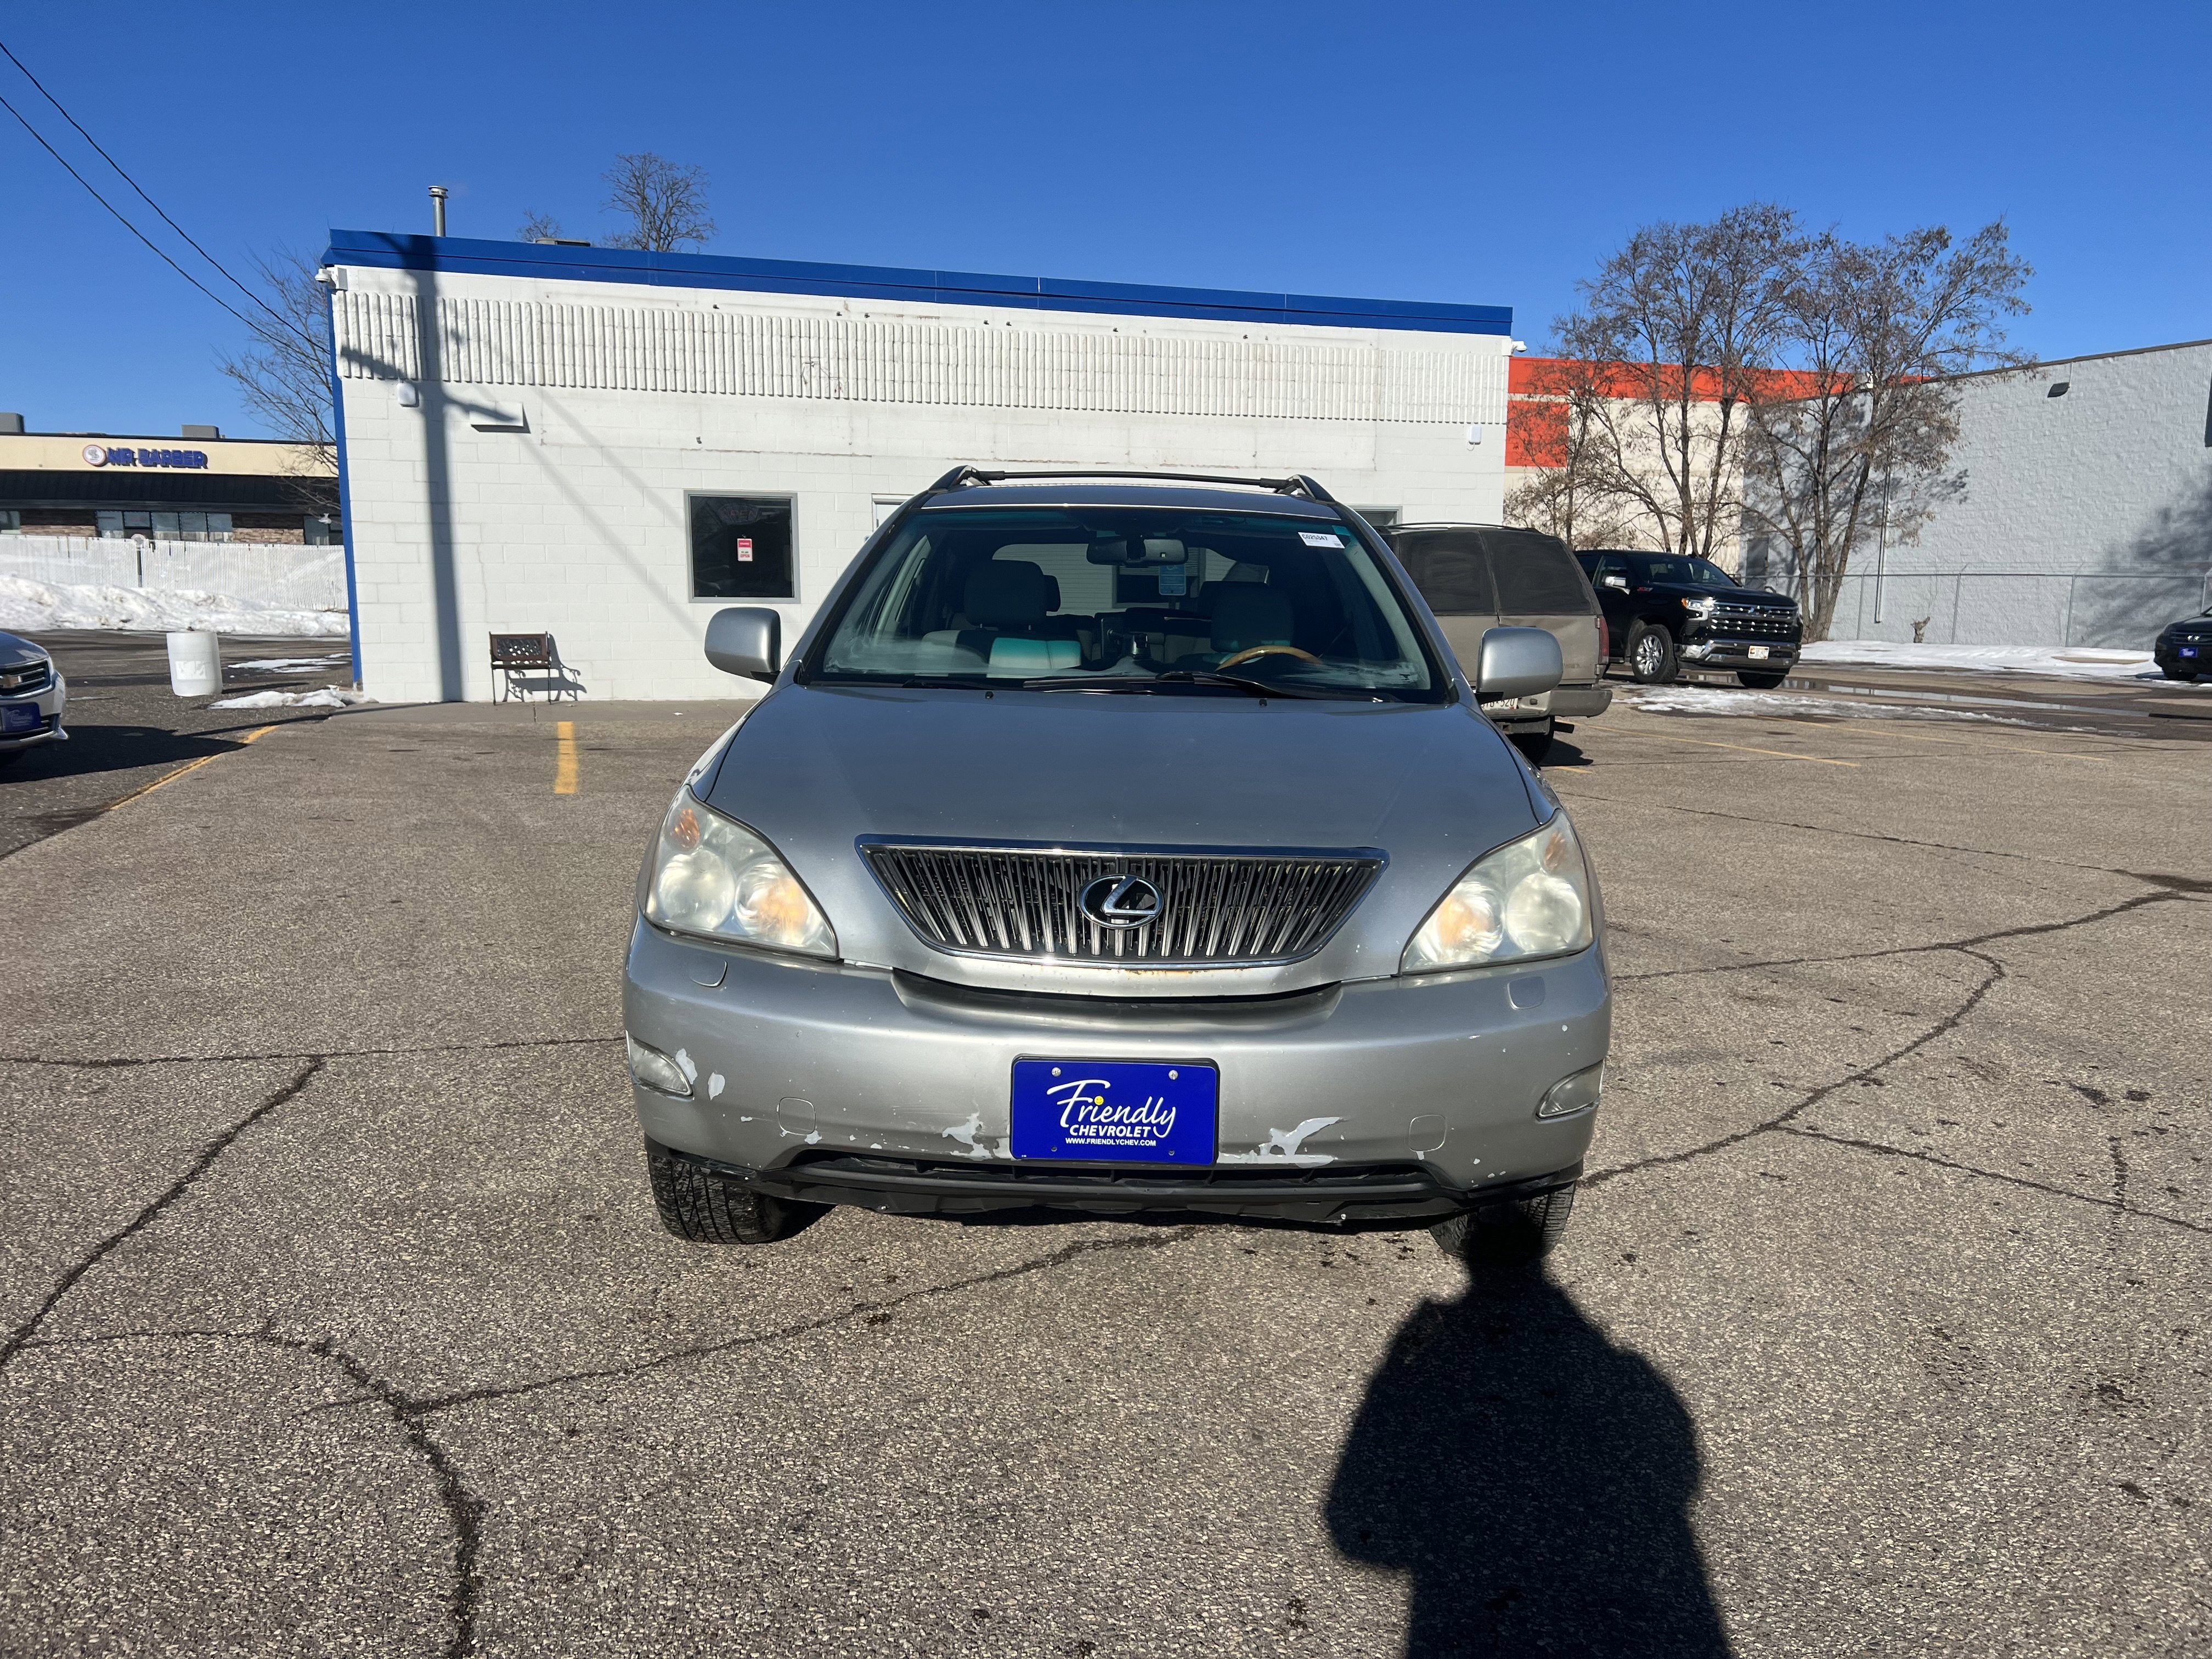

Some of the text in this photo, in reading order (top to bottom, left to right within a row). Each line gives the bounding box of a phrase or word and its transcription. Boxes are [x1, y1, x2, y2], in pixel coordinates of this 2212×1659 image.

[137, 448, 208, 469] BARBER
[1046, 1079, 1176, 1138] Friendly
[1069, 1124, 1152, 1138] CHEVROLET
[1065, 1137, 1156, 1147] WWW.FRIENDLYCHEV.COM
